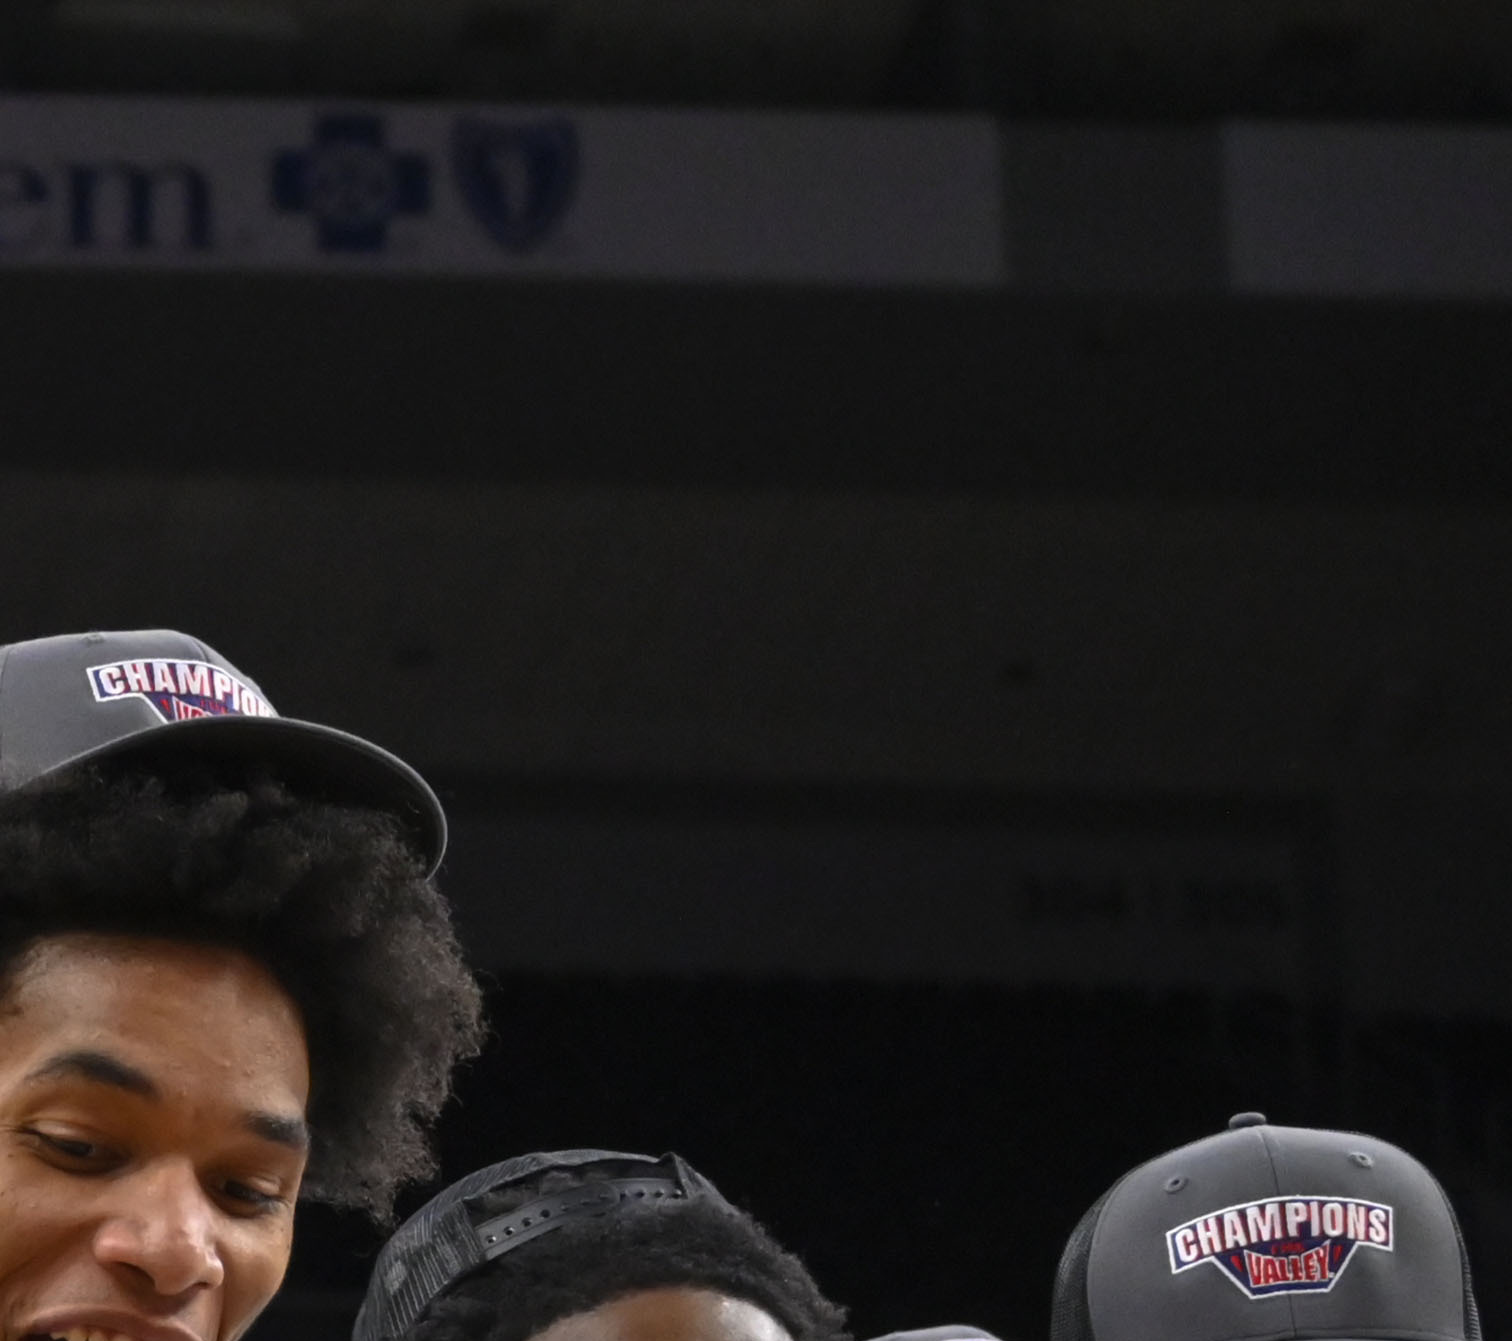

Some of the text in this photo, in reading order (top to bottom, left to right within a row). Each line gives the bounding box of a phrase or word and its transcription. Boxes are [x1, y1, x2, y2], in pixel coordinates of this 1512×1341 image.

[99, 662, 276, 718] CHAMPIO
[1174, 1201, 1387, 1263] CHAMPIONS
[1244, 1240, 1331, 1288] VALLEY
